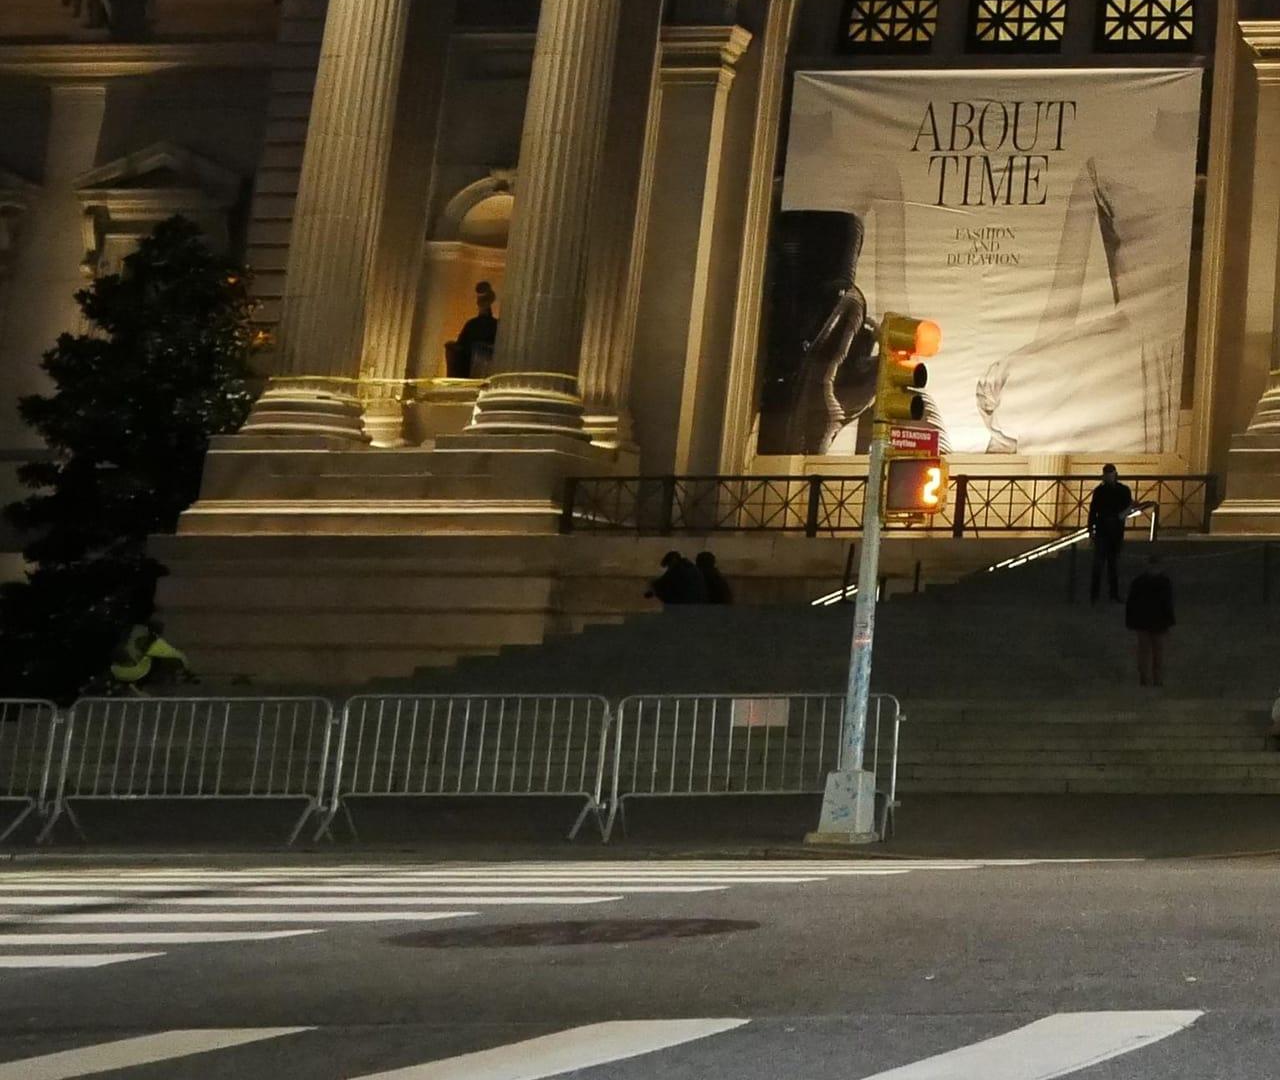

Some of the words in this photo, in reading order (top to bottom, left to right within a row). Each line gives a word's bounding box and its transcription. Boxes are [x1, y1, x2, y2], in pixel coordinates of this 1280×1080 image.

[909, 100, 1077, 152] ABOUT
[928, 155, 1049, 206] TIME
[954, 226, 1017, 240] FASHION
[970, 240, 1000, 253] AND
[946, 253, 1020, 265] DURATION
